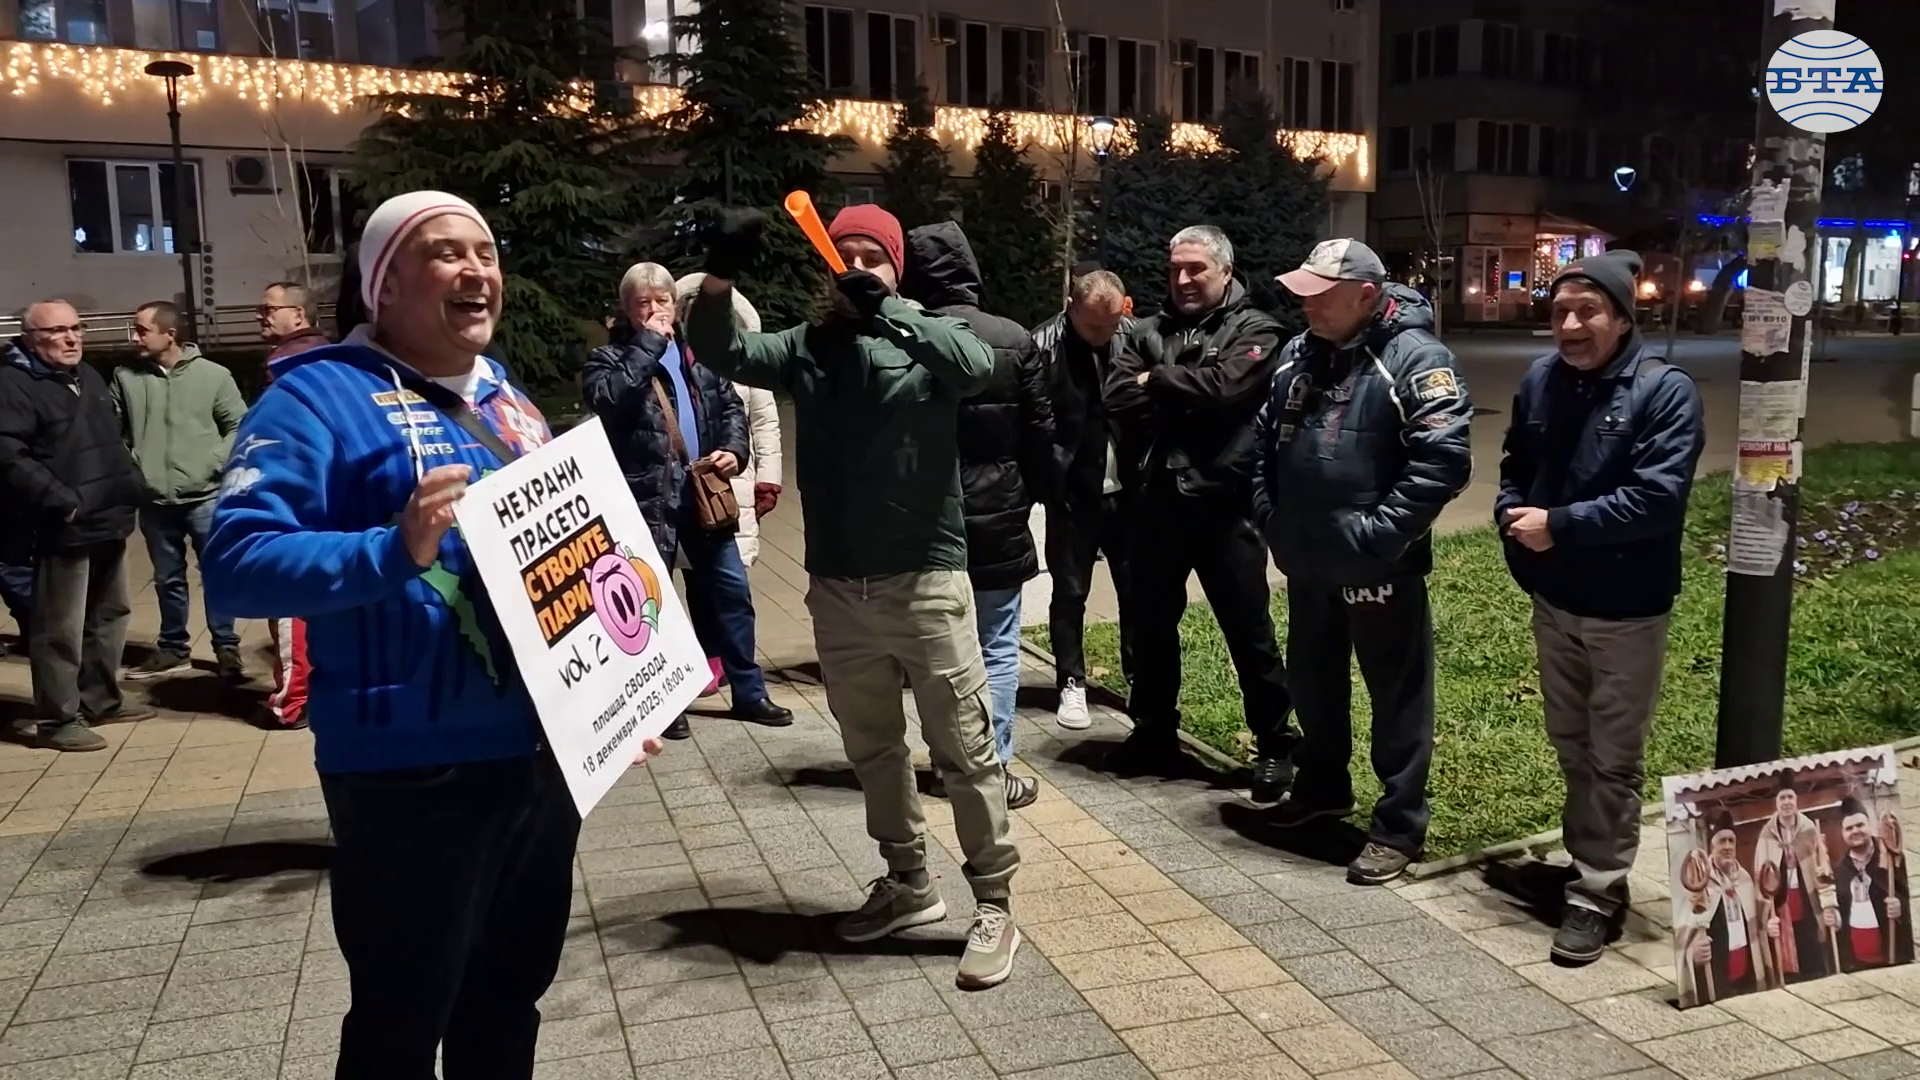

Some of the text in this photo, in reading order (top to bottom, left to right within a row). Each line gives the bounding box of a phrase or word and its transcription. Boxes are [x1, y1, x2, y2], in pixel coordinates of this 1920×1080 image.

[509, 494, 590, 565] ПРАСЕТО
[537, 579, 593, 641] ПАРИ
[588, 634, 609, 666] 2
[582, 756, 596, 777] 18
[597, 715, 638, 769] декември
[662, 667, 684, 696] 18:00
[592, 652, 667, 734] площад СВОБОДА
